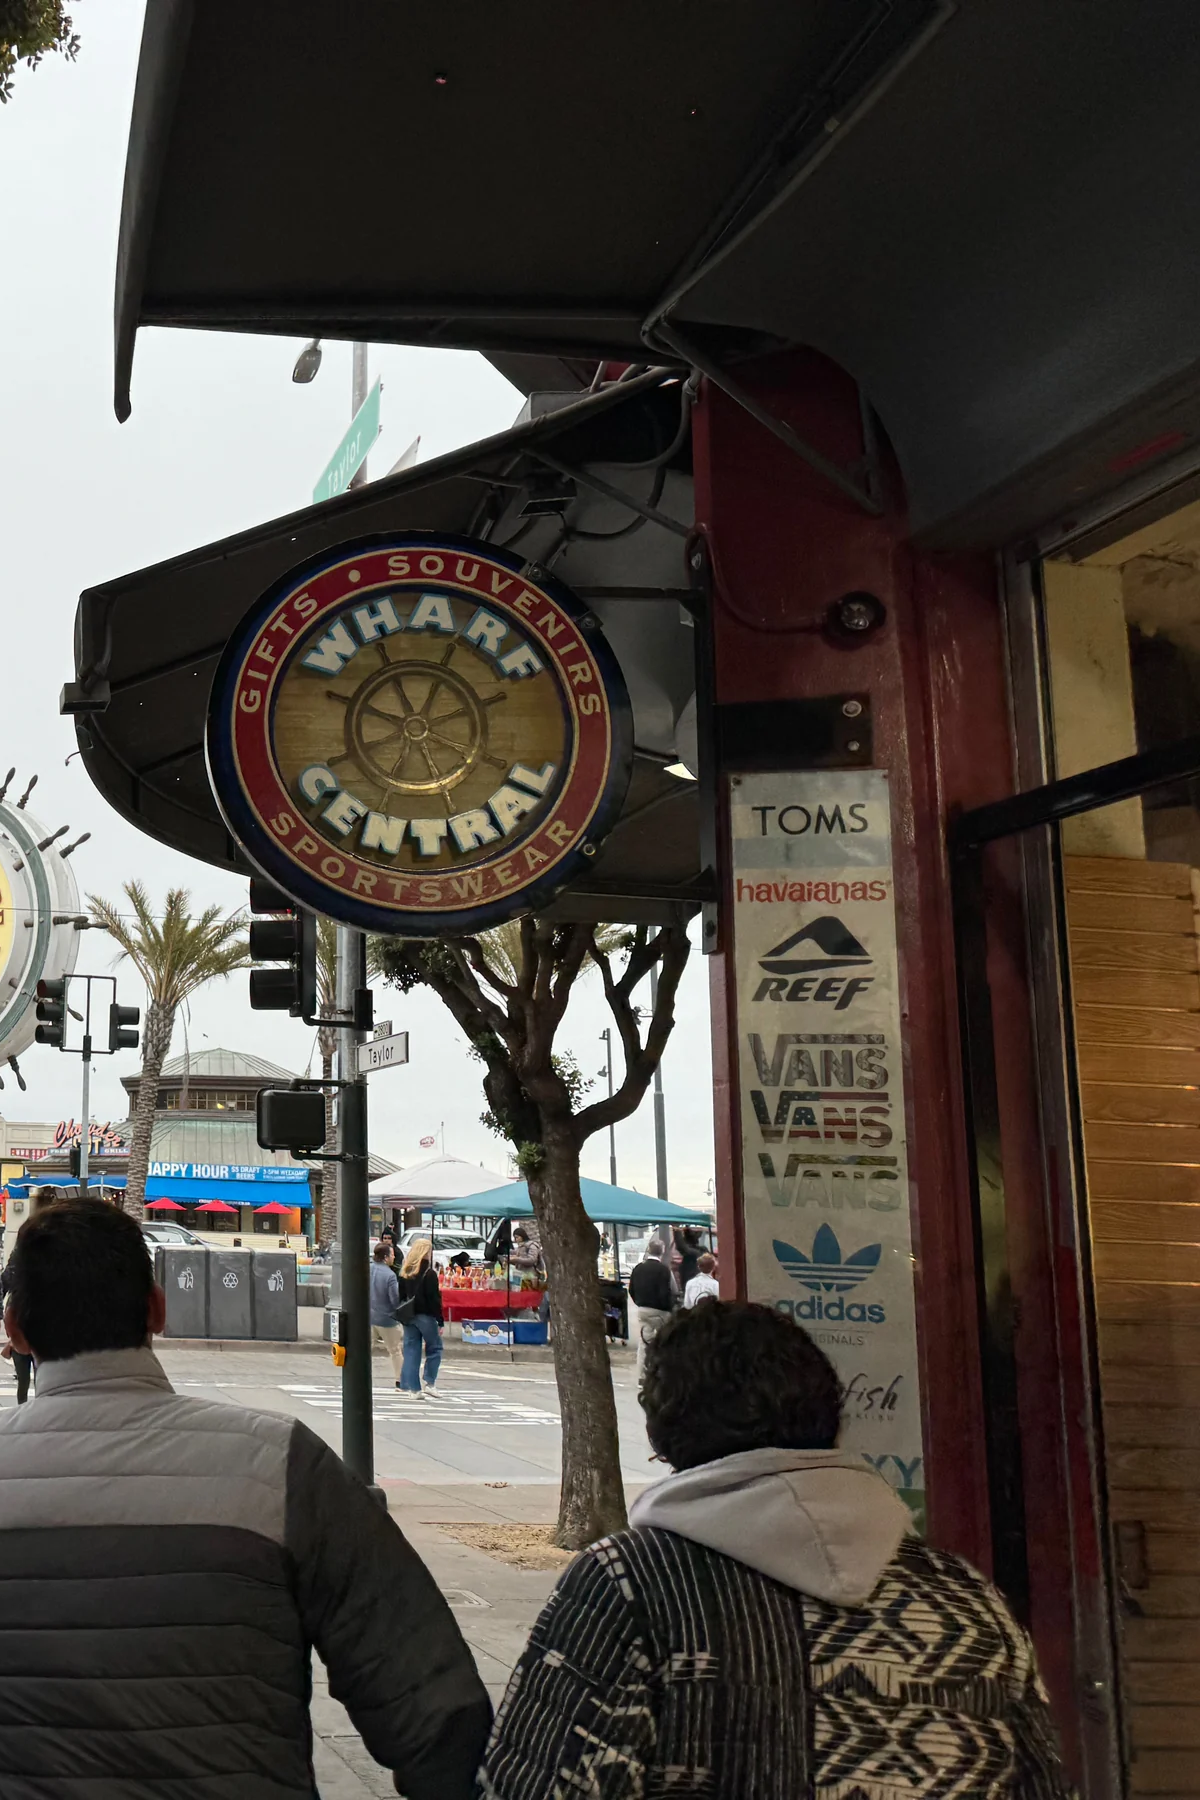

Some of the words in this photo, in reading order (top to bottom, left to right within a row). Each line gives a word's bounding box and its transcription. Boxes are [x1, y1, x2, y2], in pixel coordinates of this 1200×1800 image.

[328, 431, 362, 499] Taylor
[239, 594, 318, 713] GIFTS
[388, 555, 602, 716] SOUVENIRS
[300, 592, 544, 679] WHARF
[300, 762, 558, 857] CENTRAL
[751, 803, 869, 836] TOMS
[269, 818, 575, 903] SPORTSWEAR
[735, 878, 887, 905] havaianas
[751, 977, 875, 1010] REEF
[368, 1045, 394, 1066] Taylor
[748, 1033, 889, 1090] VANS
[750, 1090, 893, 1148] VANS
[192, 1164, 229, 1179] HOUR
[240, 1166, 260, 1174] DRAFT
[757, 1152, 901, 1212] VANS
[775, 1295, 886, 1324] adidas
